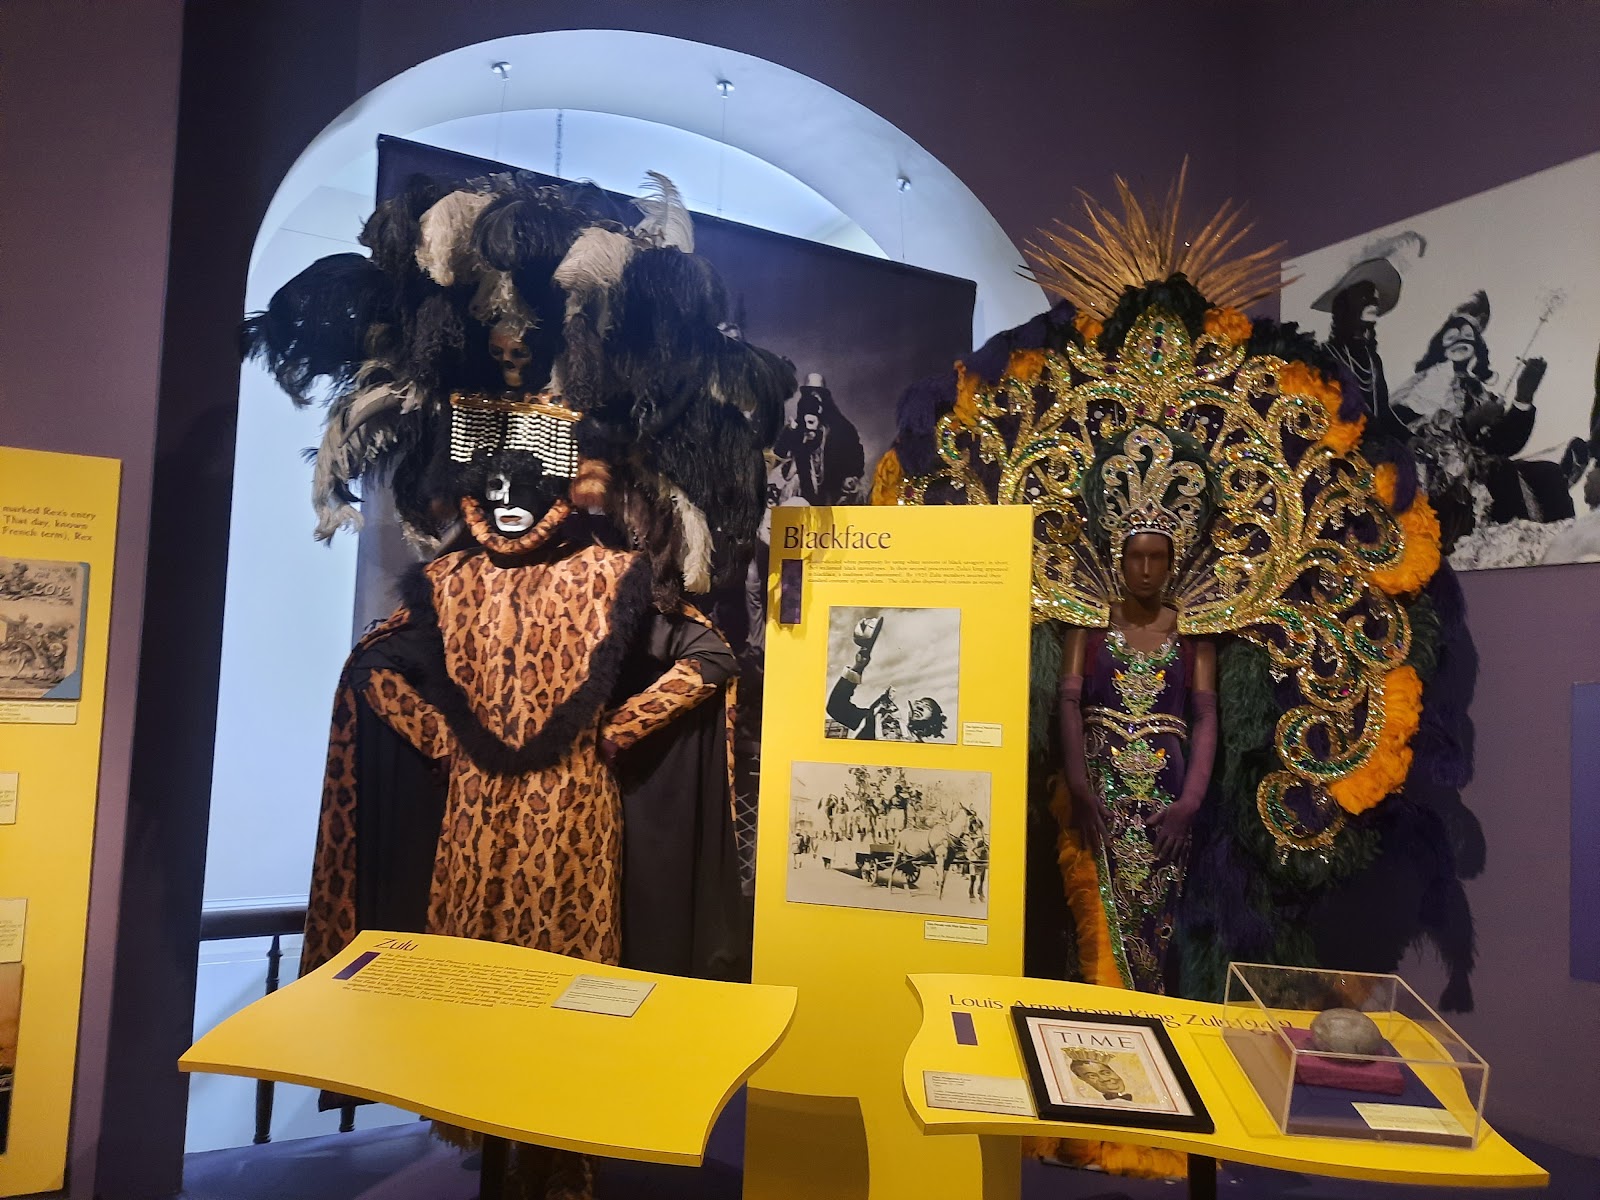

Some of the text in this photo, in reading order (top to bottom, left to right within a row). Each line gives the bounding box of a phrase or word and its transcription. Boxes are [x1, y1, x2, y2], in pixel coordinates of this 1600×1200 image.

[2, 506, 40, 515] marked
[71, 511, 96, 521] entry
[4, 514, 28, 524] That
[55, 519, 89, 529] known
[2, 525, 37, 537] French
[74, 532, 93, 541] Rex
[783, 524, 892, 550] Blackface
[373, 937, 419, 952] Zulu
[949, 994, 1004, 1010] Louis
[1128, 1009, 1181, 1029] King
[1181, 1012, 1232, 1028] Zulu
[1053, 1030, 1136, 1050] TIME
